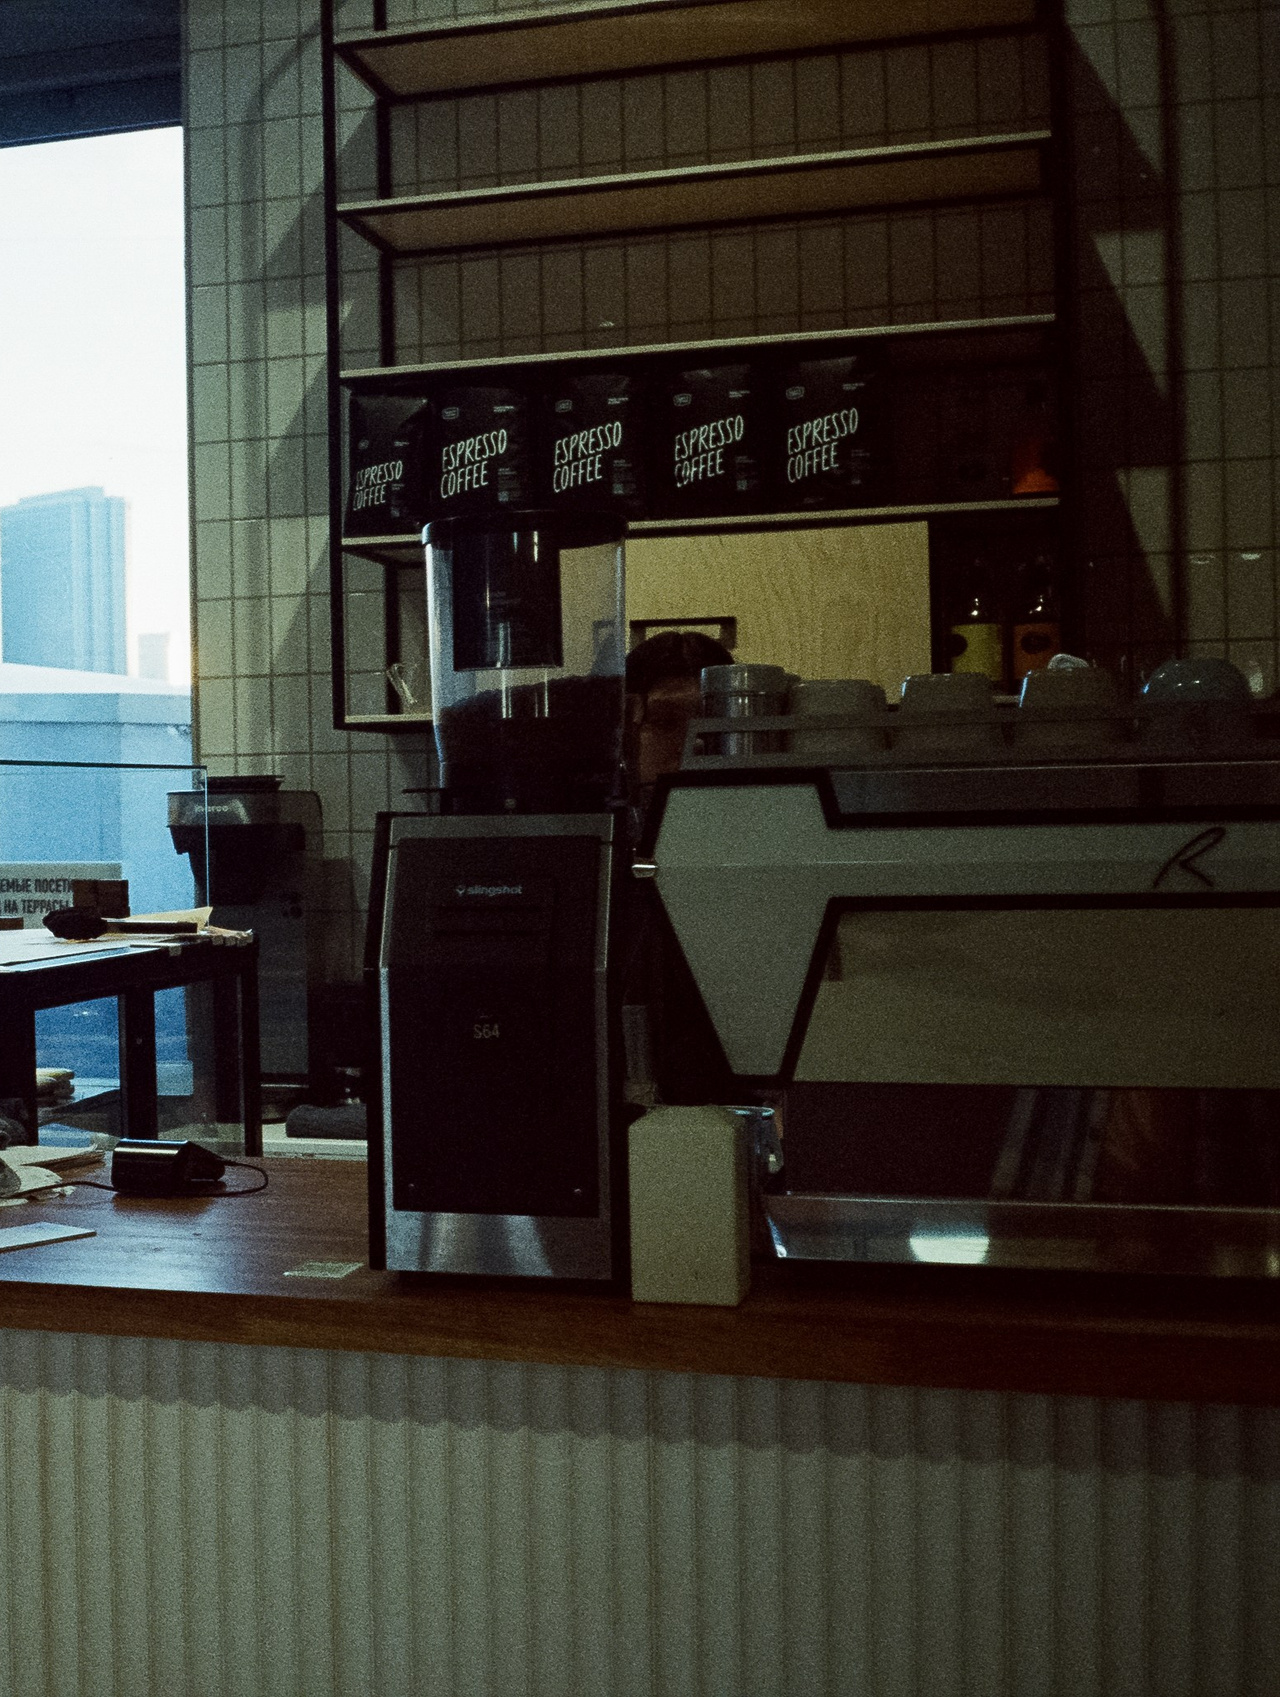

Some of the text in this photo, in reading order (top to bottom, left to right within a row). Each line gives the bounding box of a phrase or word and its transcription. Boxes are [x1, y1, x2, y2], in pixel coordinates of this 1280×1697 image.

[442, 428, 507, 473] ESPRESSO
[554, 421, 622, 466] ESPRESSO
[674, 415, 744, 461] ESPRESSO
[787, 407, 859, 455] ESPRESSO
[356, 460, 403, 491] ESPRESSO
[440, 460, 489, 499] COFFEE
[553, 454, 603, 494] COFFEE
[674, 449, 725, 488] COFFEE
[786, 442, 839, 484] COFFEE
[353, 484, 386, 511] COFFEE
[4, 899, 18, 914] НА
[467, 884, 523, 898] slingshot
[472, 1022, 500, 1040] S64
